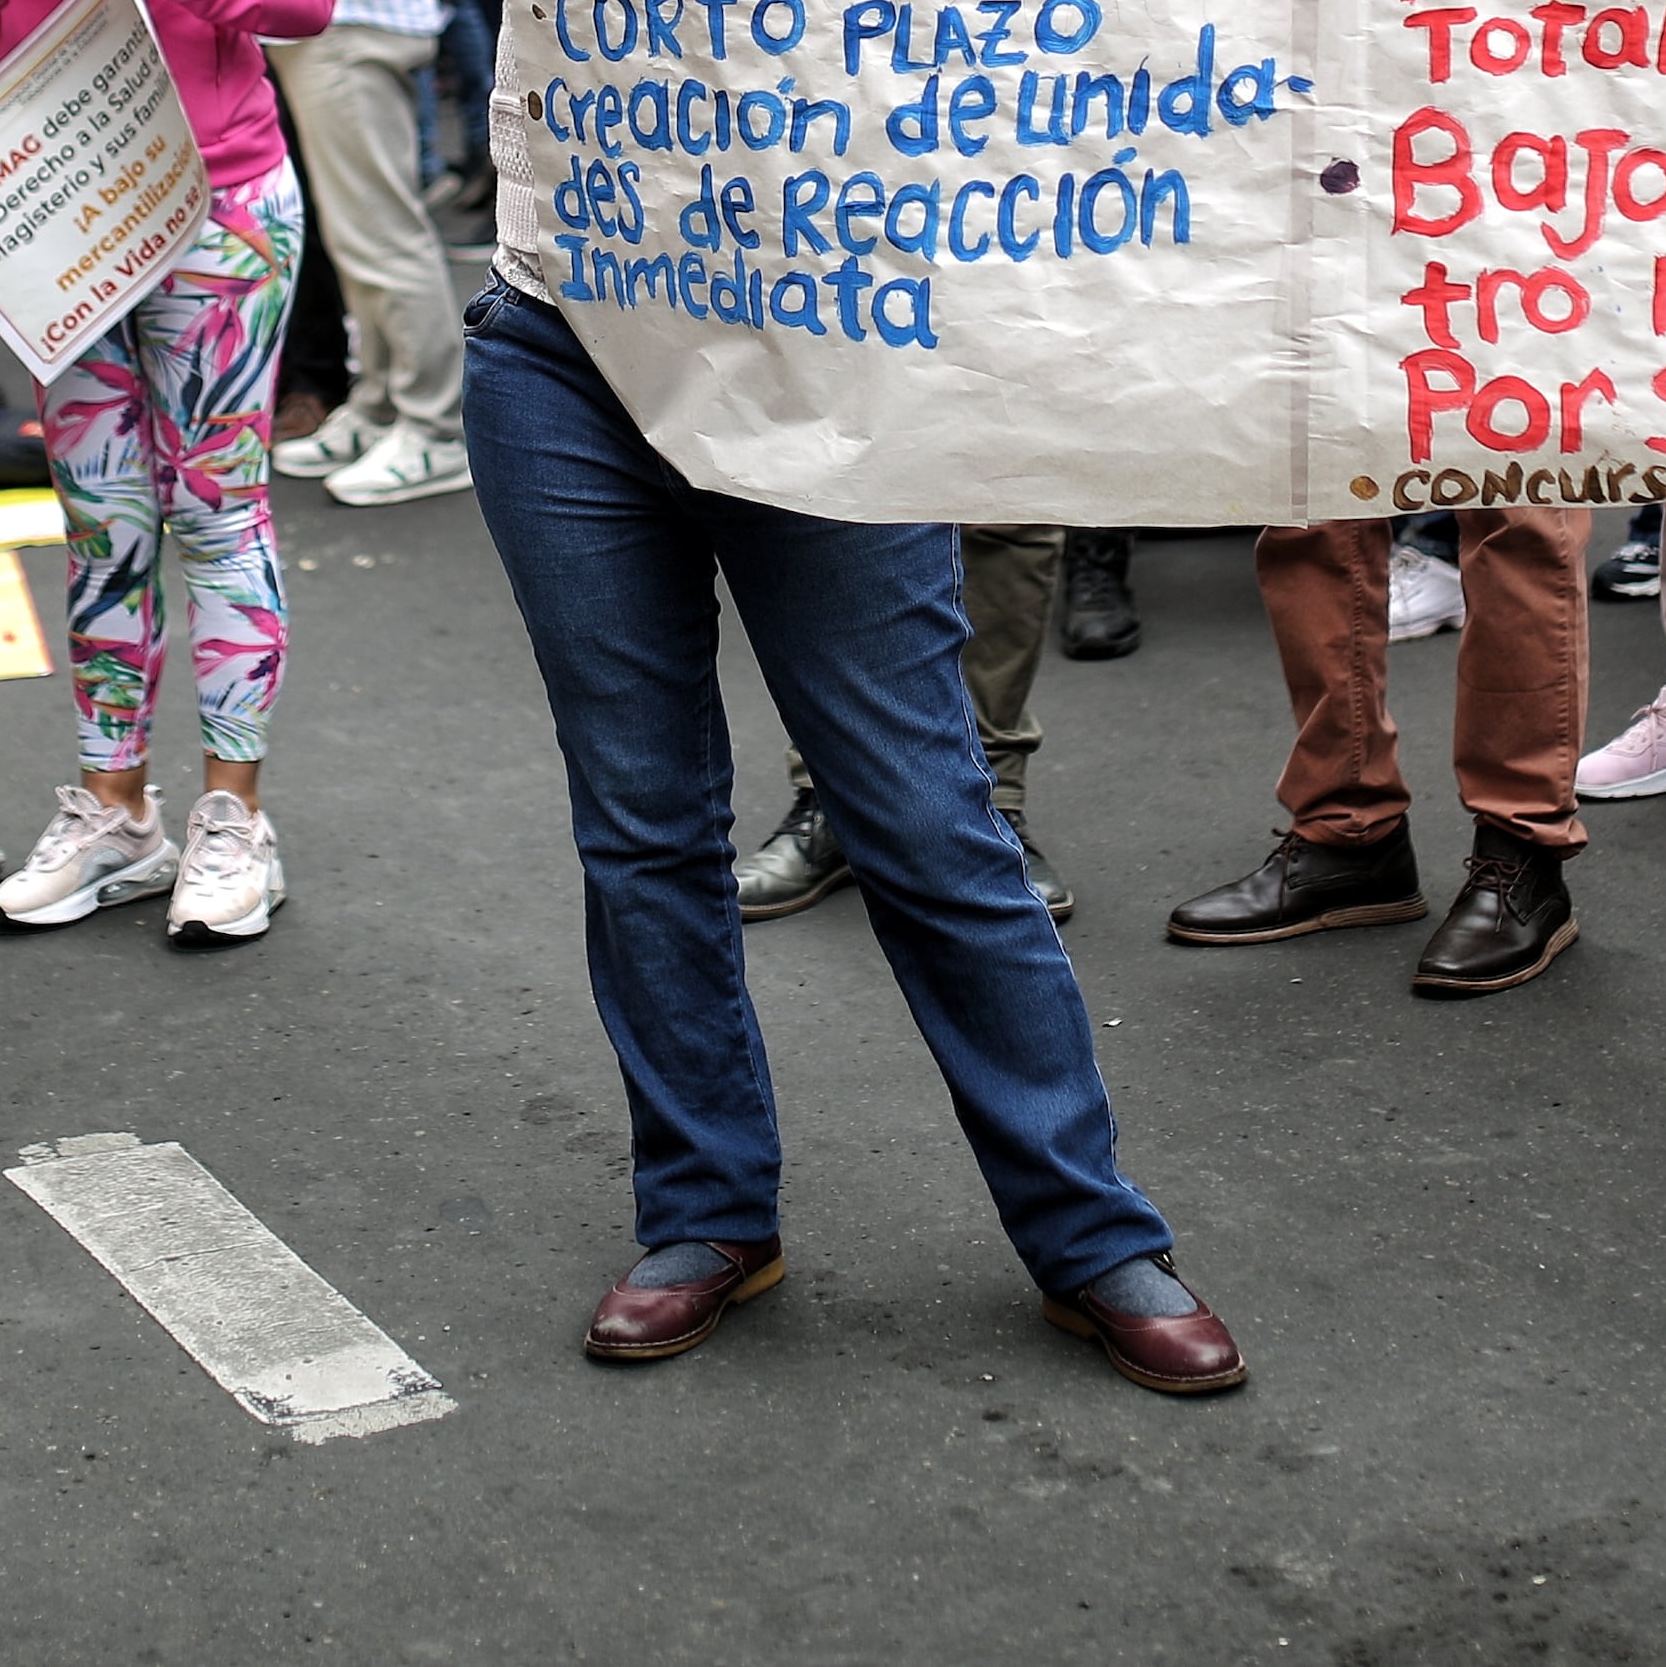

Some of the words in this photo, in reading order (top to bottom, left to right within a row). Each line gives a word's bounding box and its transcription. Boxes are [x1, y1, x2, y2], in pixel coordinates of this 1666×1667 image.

[41, 88, 93, 140] debe
[79, 130, 92, 146] a
[87, 109, 111, 133] la
[107, 58, 151, 115] Salud
[90, 153, 106, 177] y
[104, 120, 137, 158] sus
[97, 158, 146, 206] bajo
[144, 134, 167, 162] su
[554, 154, 645, 245] des
[679, 162, 760, 254] de
[39, 298, 95, 354] ¡Con
[91, 278, 119, 305] la
[113, 232, 167, 279] Vida
[165, 206, 188, 235] no
[553, 233, 940, 349] Inmediata
[1400, 261, 1591, 350] tro
[1398, 346, 1619, 465] Por
